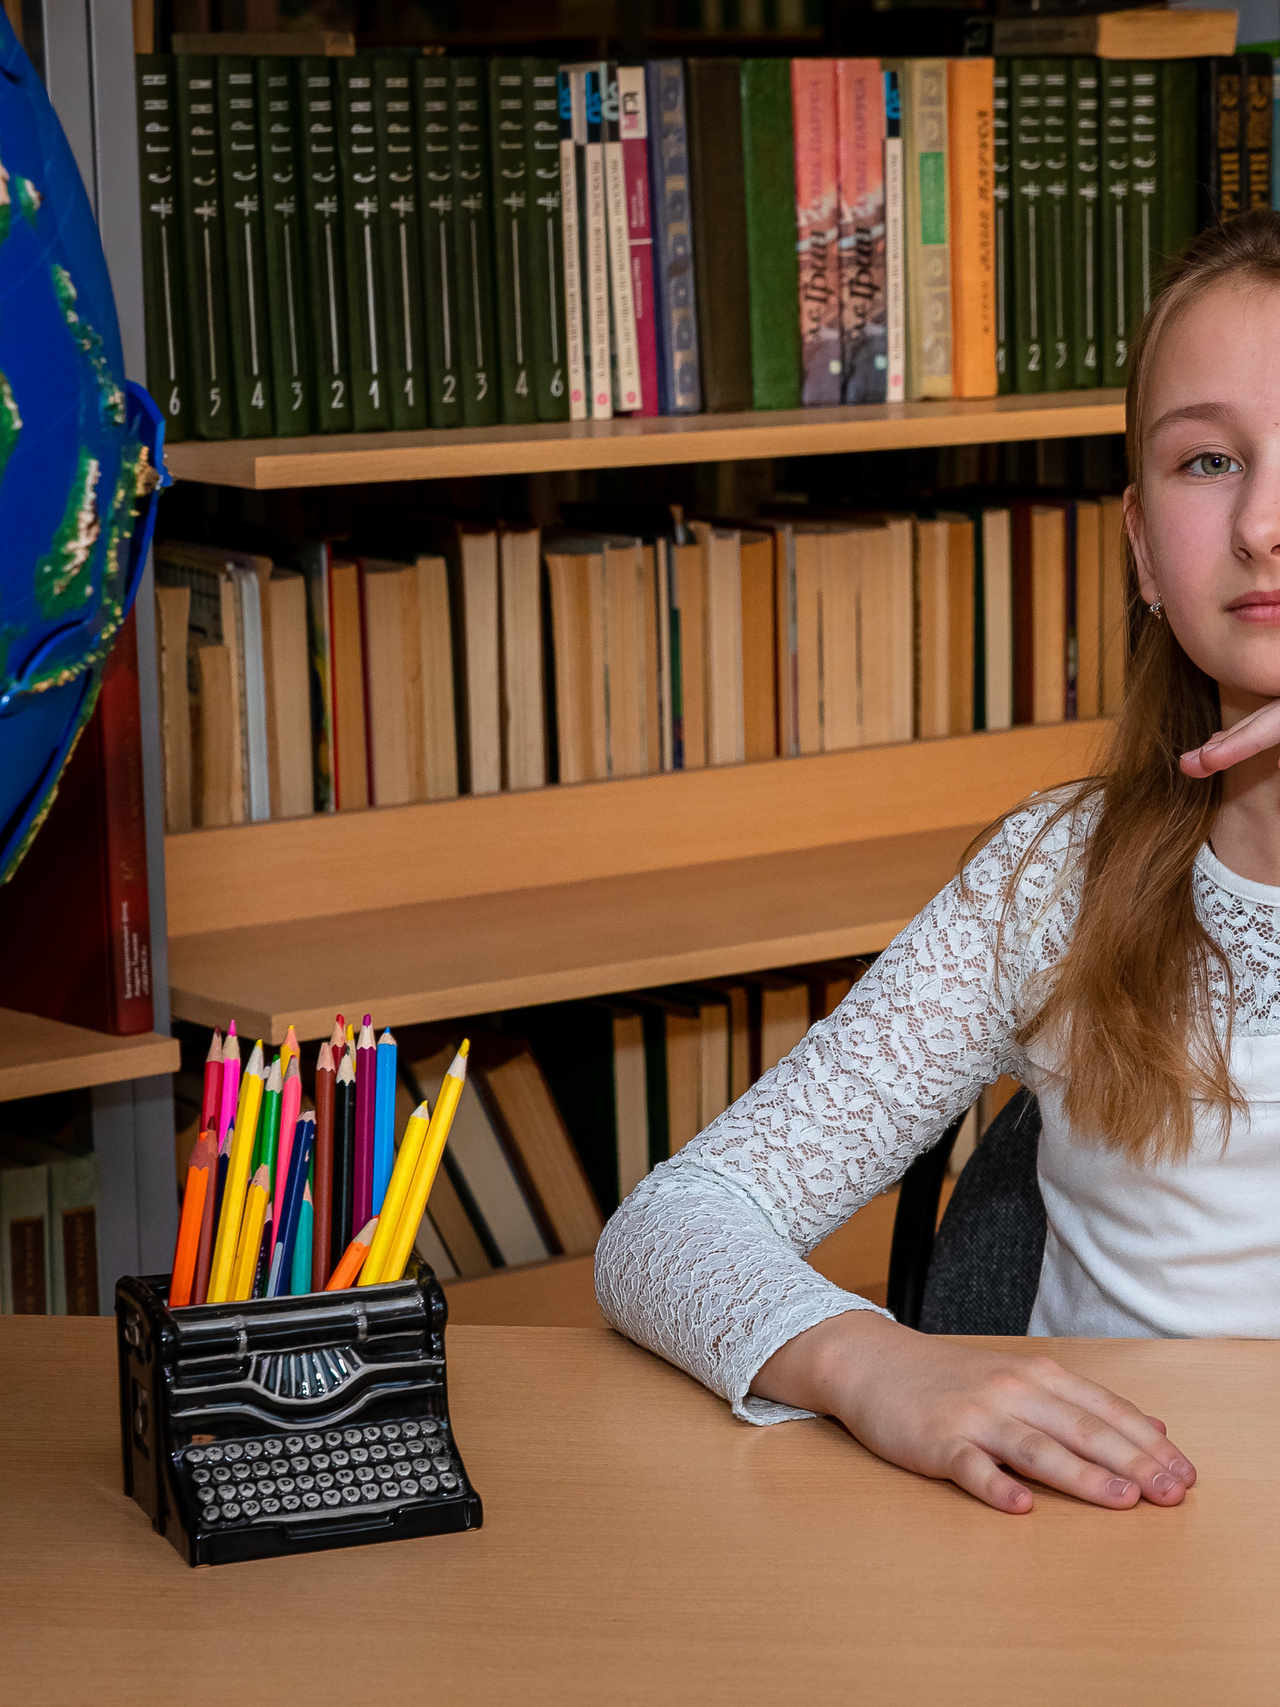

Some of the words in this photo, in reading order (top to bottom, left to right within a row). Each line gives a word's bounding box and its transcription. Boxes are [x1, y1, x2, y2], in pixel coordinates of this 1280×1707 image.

[142, 73, 170, 153] ГРИН
[189, 78, 214, 156] ГРИН
[228, 72, 255, 151] ГРИН
[267, 75, 291, 153] ГРИН
[307, 76, 334, 153] ГРИН
[348, 76, 374, 154] ГРИН
[385, 77, 411, 152] ГРИН
[423, 77, 449, 152] ГРИН
[455, 76, 479, 151] ГРИН
[499, 75, 523, 149] ГРИН
[532, 76, 558, 150] ГРИН
[1019, 74, 1041, 143] ГРИН
[1044, 74, 1066, 142] ГРИН
[1077, 77, 1097, 145] ГРИН
[1108, 76, 1128, 143] ГРИН
[1133, 74, 1156, 142] ГРИН
[476, 372, 488, 400] 3
[515, 369, 528, 398] 4
[550, 369, 564, 398] 6
[1027, 344, 1041, 371] 2
[1054, 342, 1067, 369] 3
[1084, 345, 1096, 367] 4
[1116, 340, 1127, 367] 5
[168, 386, 181, 416] 6
[209, 388, 221, 416] 5
[251, 381, 264, 409] 4
[291, 381, 303, 409] 3
[331, 380, 345, 408] 2
[368, 379, 381, 408] 1
[404, 375, 414, 406] 1
[442, 376, 456, 404] 2
